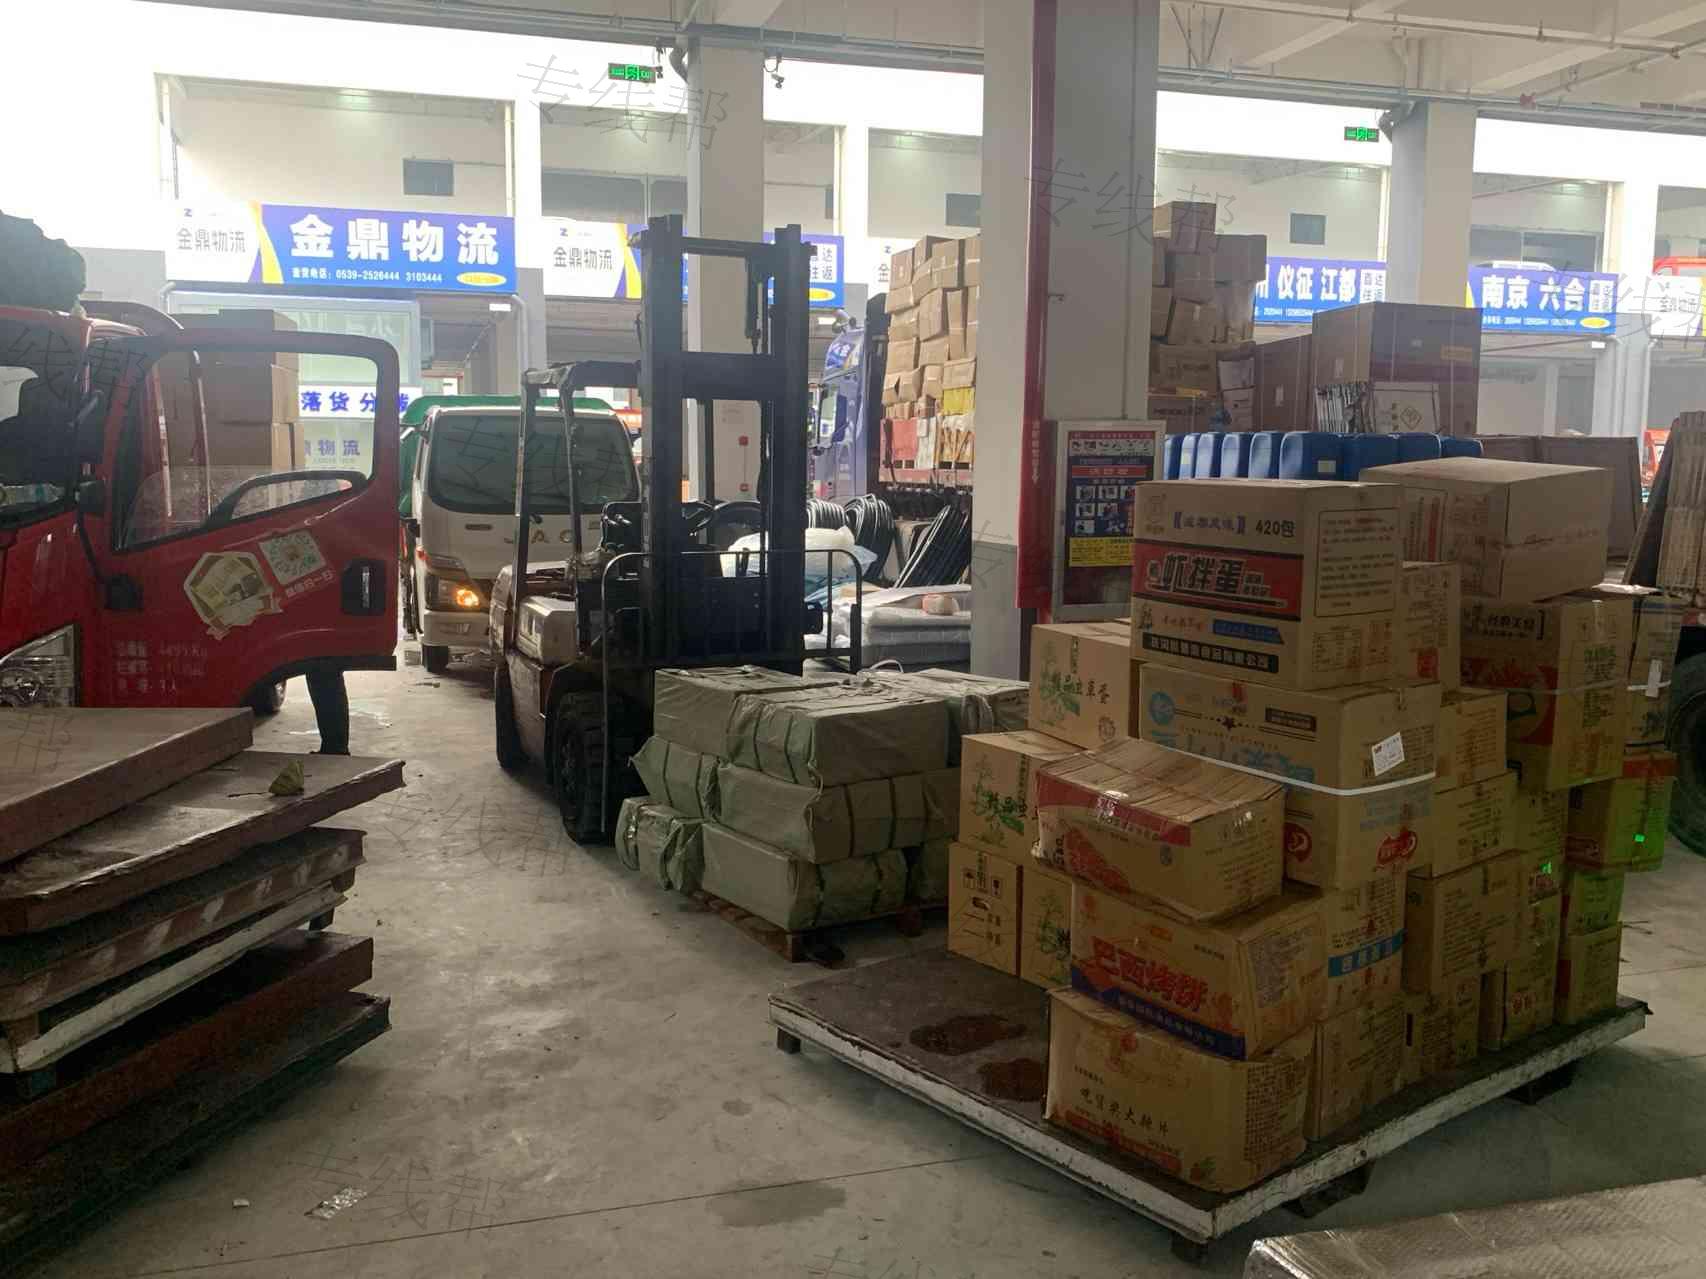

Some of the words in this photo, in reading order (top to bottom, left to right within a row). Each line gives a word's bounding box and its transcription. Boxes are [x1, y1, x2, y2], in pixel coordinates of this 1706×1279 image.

[175, 227, 247, 253] 金鼎物流
[290, 214, 499, 265] 金鼎物流
[553, 246, 613, 271] 金鼎物流
[1277, 264, 1314, 300] 仪征
[1320, 265, 1357, 302] 江都
[1482, 274, 1530, 309] 南京
[1539, 277, 1585, 312] 六合
[301, 391, 409, 412] 落货分
[1256, 519, 1295, 538] 420包
